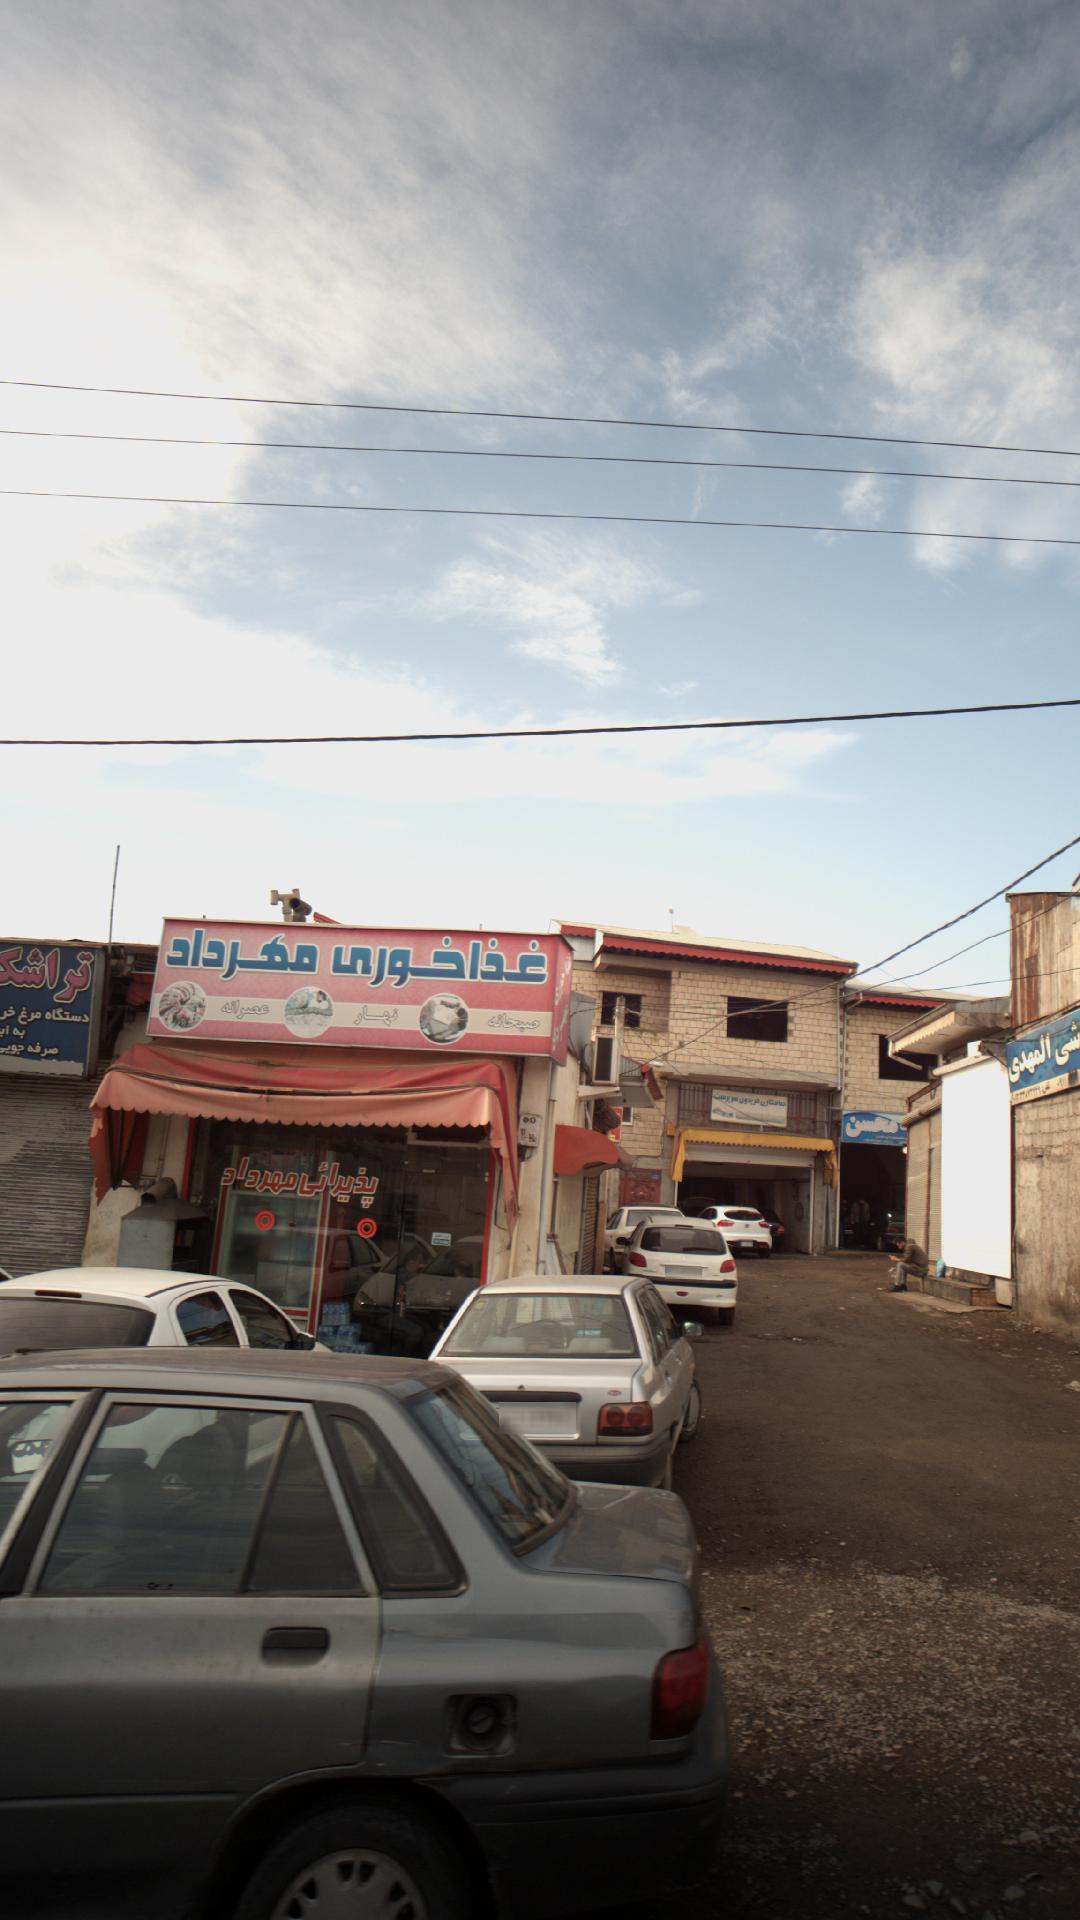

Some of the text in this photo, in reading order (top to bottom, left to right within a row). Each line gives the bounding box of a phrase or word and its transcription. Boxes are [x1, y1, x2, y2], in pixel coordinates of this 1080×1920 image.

[165, 929, 549, 988] غذاخوری مهرداد
[18, 1006, 41, 1024] مرغ
[45, 1008, 90, 1023] دستگاه
[220, 1000, 541, 1032] صبحانه نهار عصرانه
[12, 1027, 26, 1039] به
[27, 1042, 59, 1057] صرفه
[1008, 1032, 1051, 1083] المهدی
[221, 1156, 379, 1208] پذیرائی مهرداد
